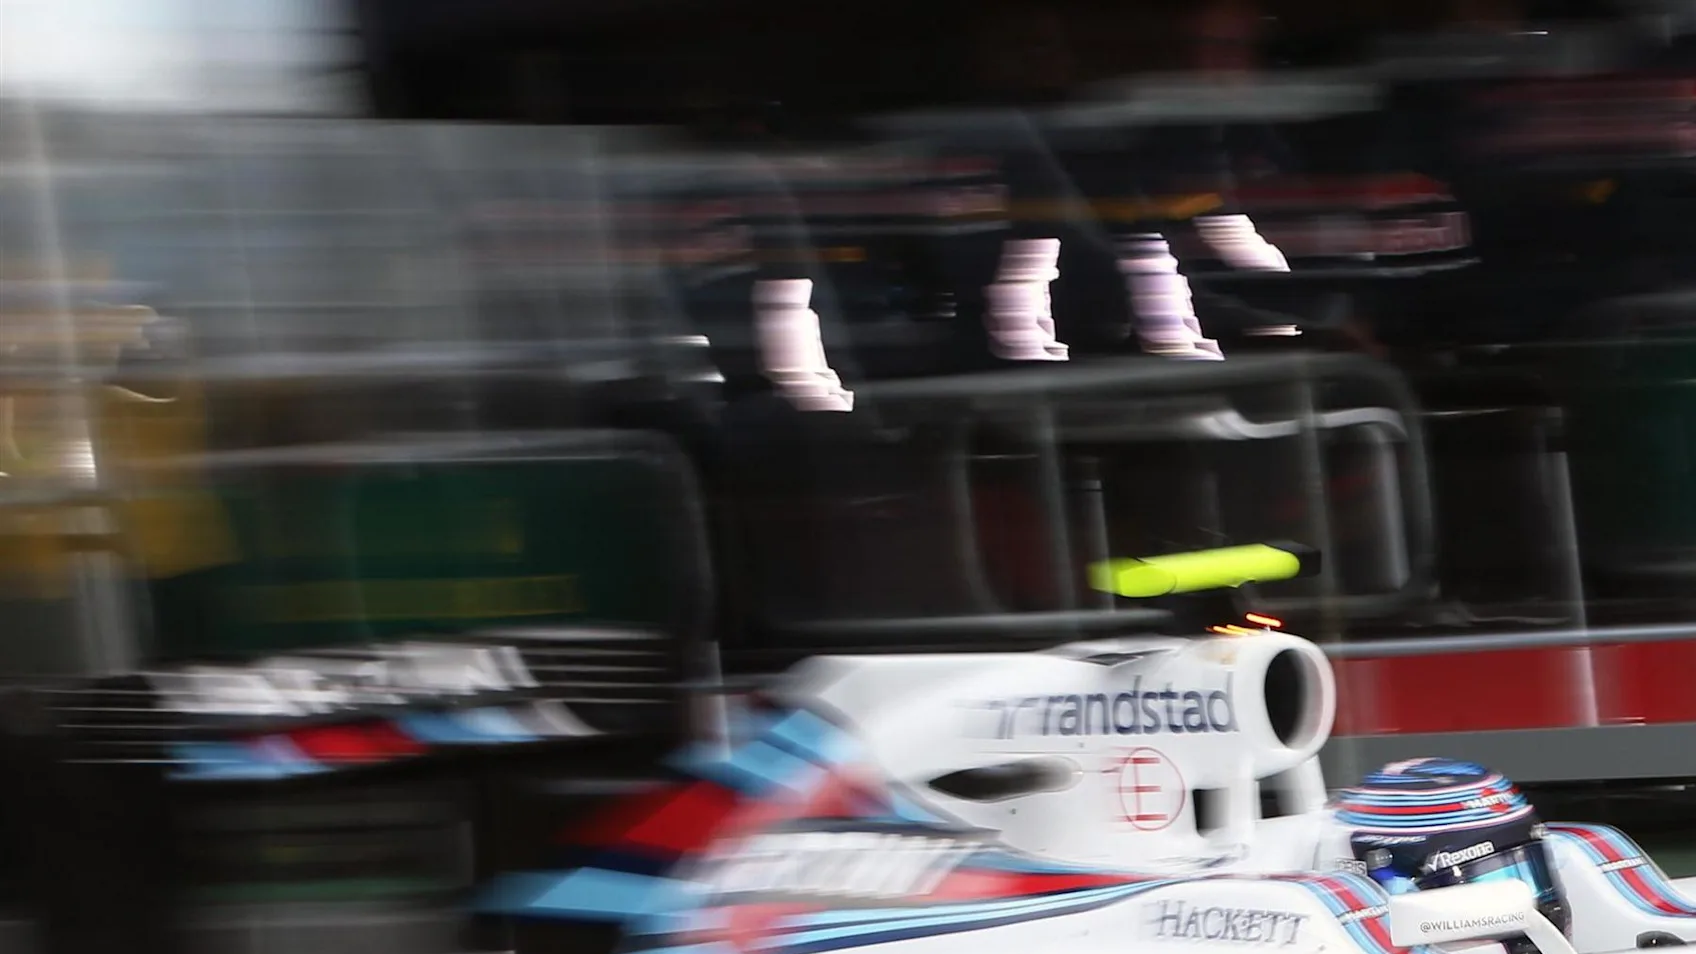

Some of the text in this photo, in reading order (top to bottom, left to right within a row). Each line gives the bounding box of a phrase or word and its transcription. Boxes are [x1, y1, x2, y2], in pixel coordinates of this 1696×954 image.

[1041, 671, 1239, 736] randstad
[1439, 840, 1496, 868] Rexona
[1152, 899, 1310, 945] HACKETT
[1420, 911, 1525, 934] @WILLIAMSRACING
